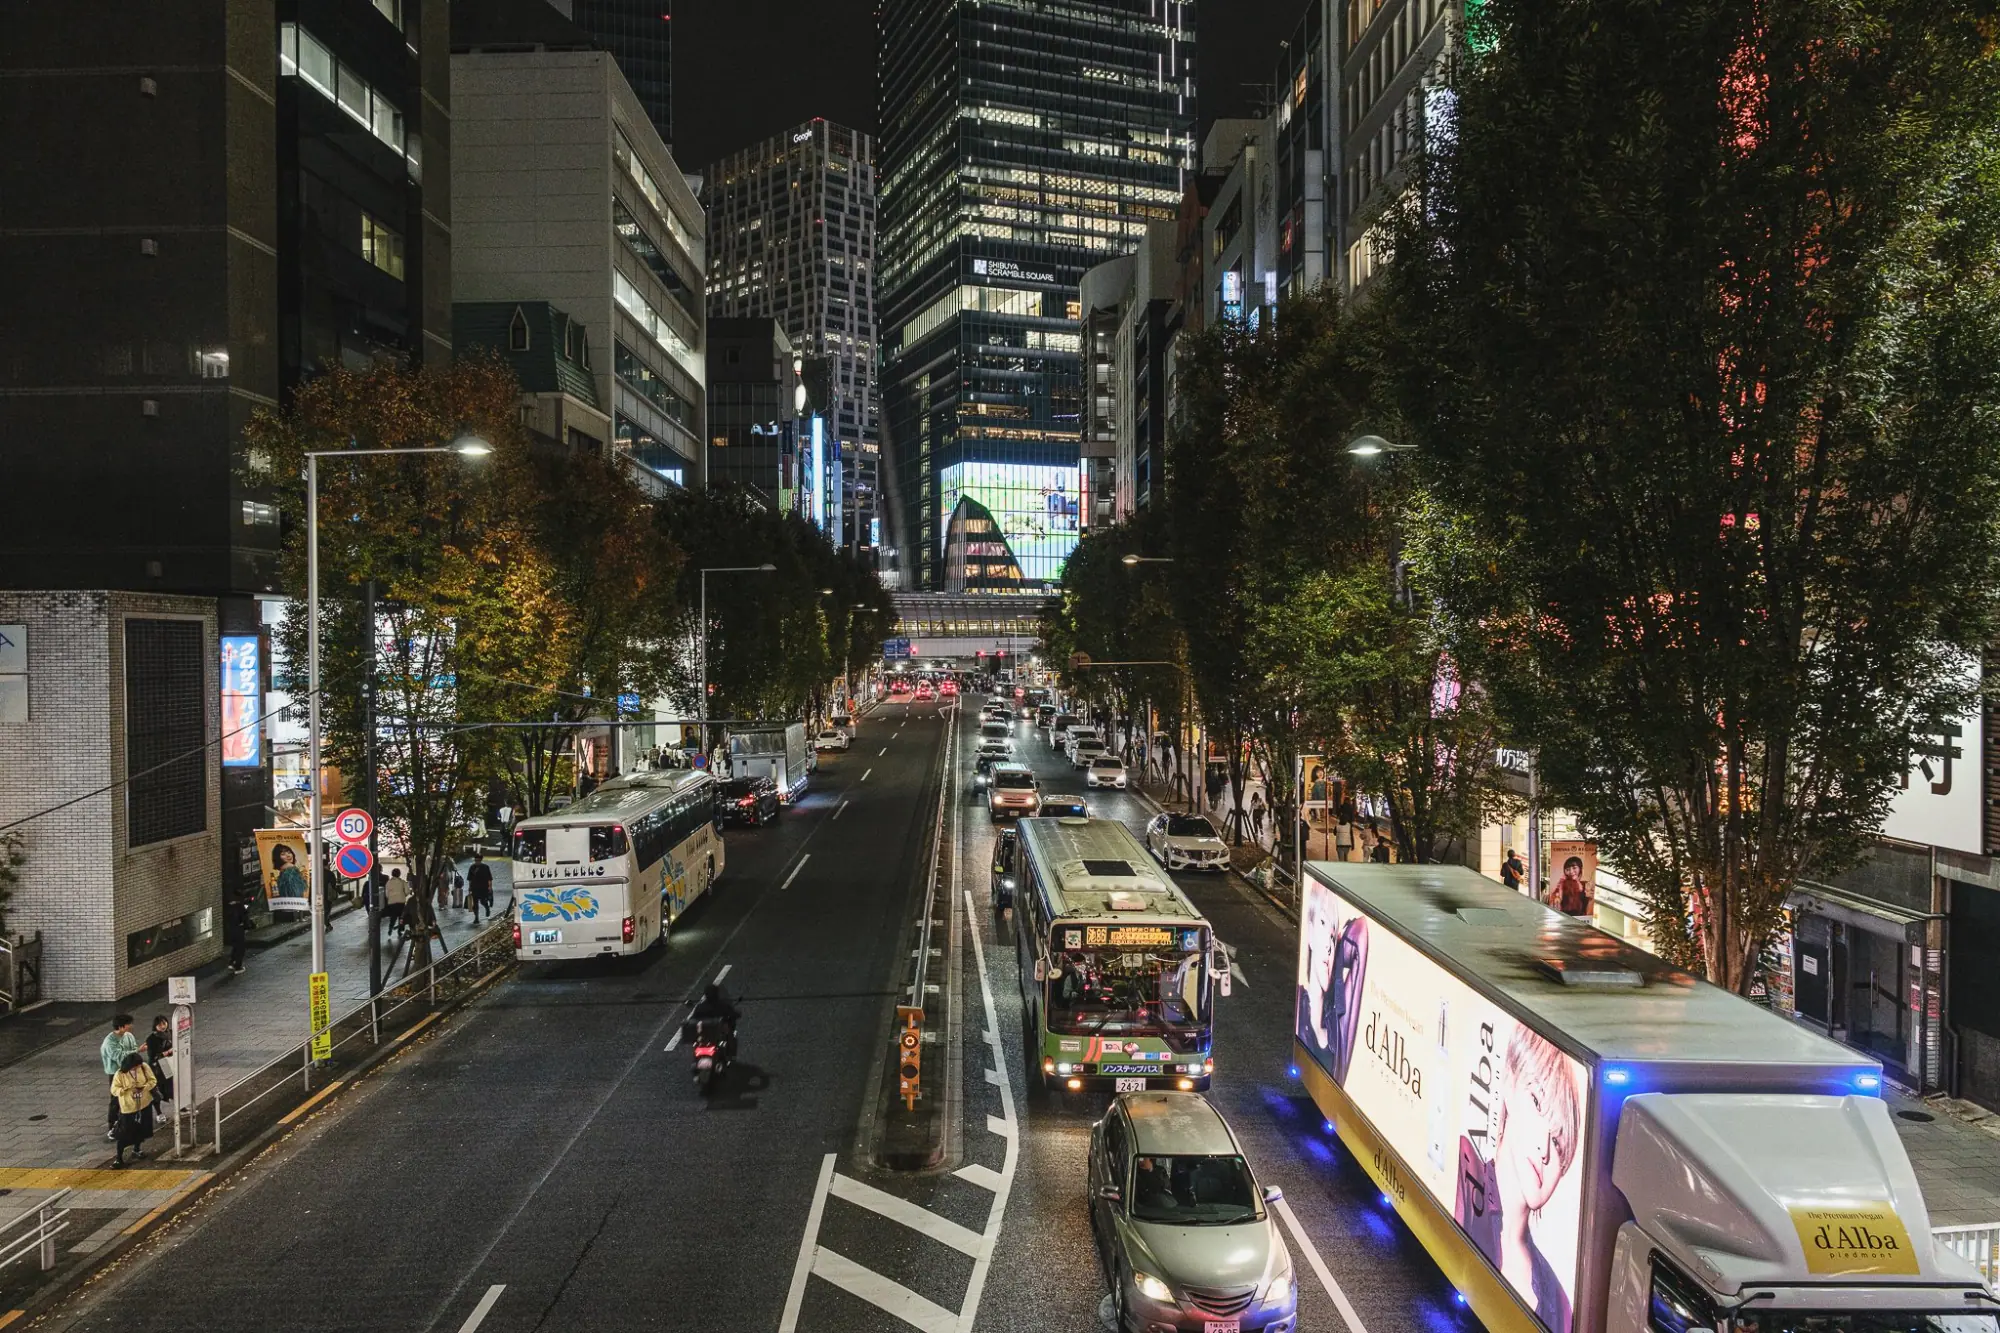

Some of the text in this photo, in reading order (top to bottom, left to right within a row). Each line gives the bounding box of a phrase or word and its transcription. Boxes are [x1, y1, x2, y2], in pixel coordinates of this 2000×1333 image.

[793, 129, 812, 143] Google
[987, 260, 1019, 271] SHIBUYA
[987, 268, 1055, 282] SCRAMBLE SQUARE
[344, 818, 364, 833] 50
[1365, 1011, 1422, 1100] d'Alba
[1103, 1065, 1159, 1073] ノンステップバス
[1465, 1021, 1495, 1218] d'Alba
[1374, 1147, 1405, 1203] d'Alba
[1807, 1212, 1884, 1221] The Premium Vegan
[1814, 1223, 1900, 1250] d'Alba
[1829, 1251, 1893, 1259] piedmont
